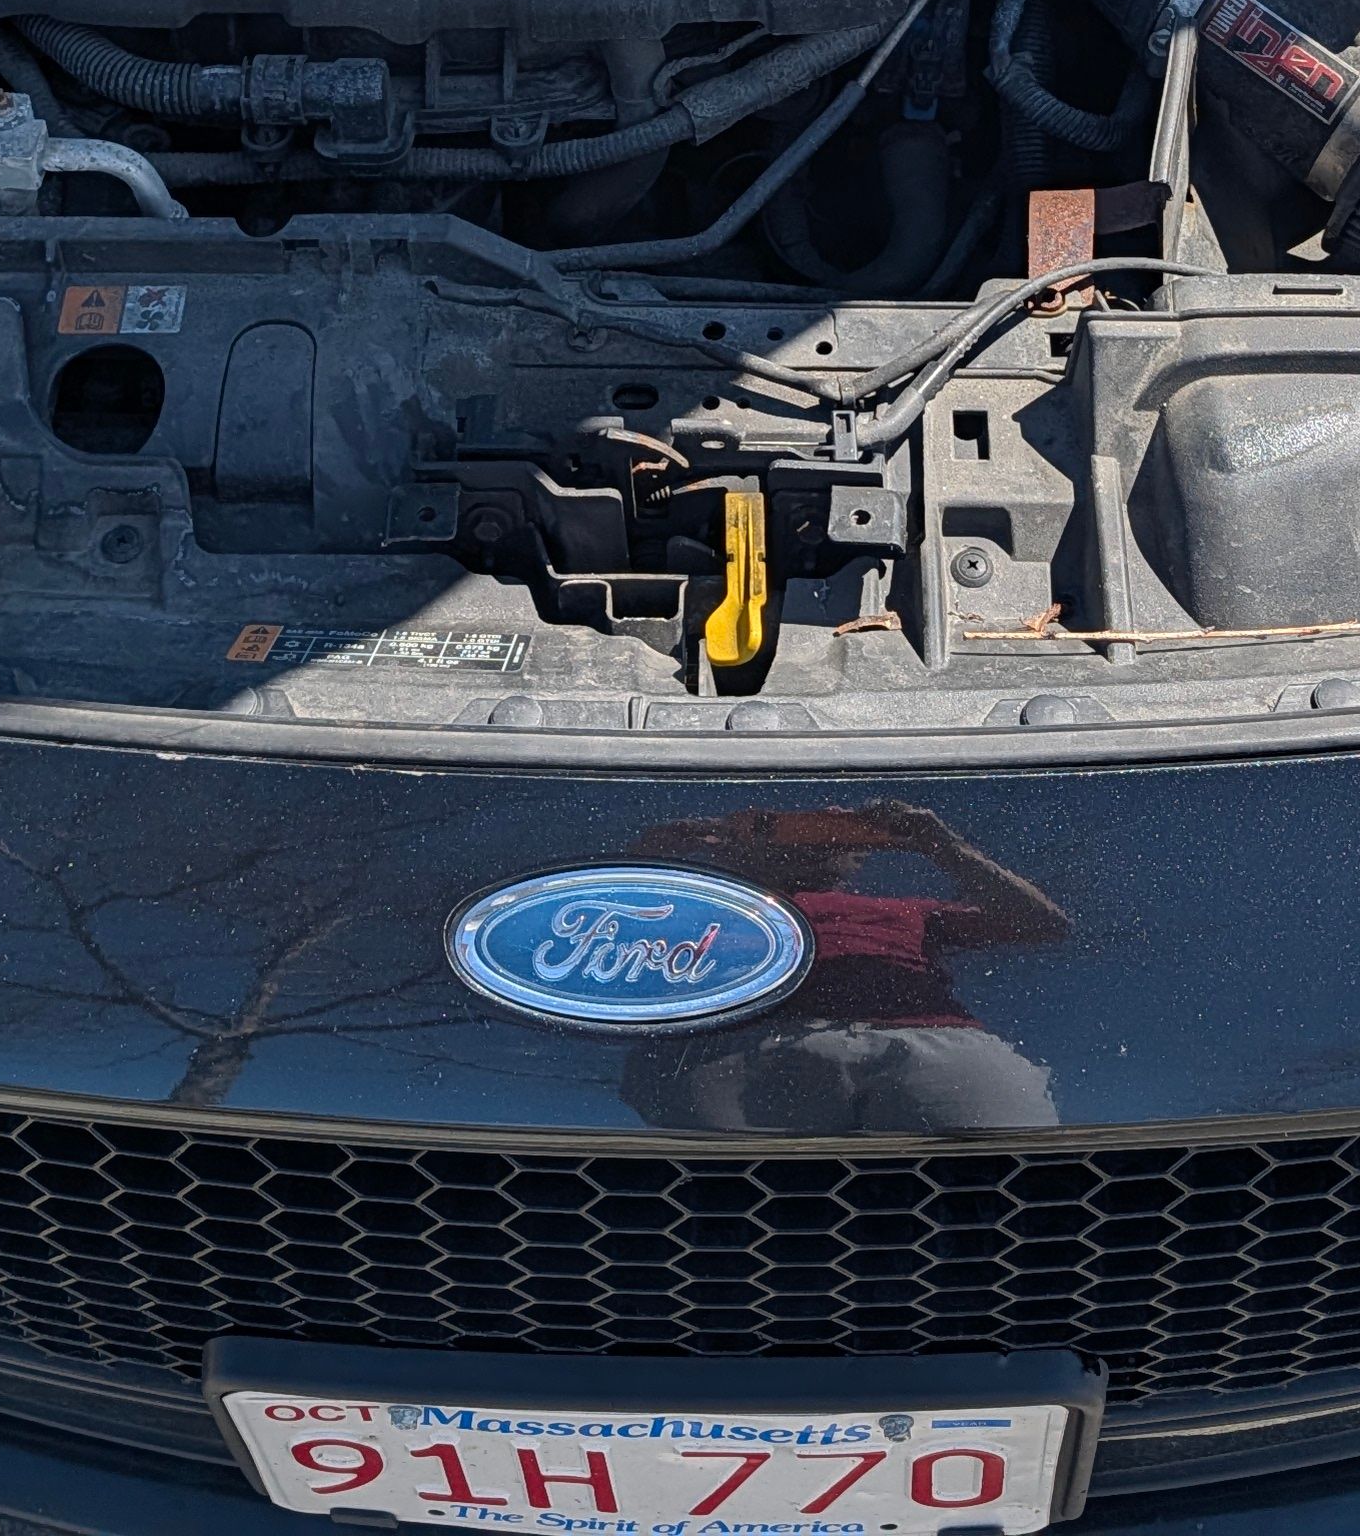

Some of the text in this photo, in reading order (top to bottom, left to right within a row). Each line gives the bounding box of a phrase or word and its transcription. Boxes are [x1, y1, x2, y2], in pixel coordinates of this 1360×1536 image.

[1233, 6, 1344, 101] injen
[328, 630, 379, 638] FoMoCo
[532, 899, 720, 984] Ford
[263, 1404, 380, 1424] OCT
[420, 1406, 871, 1445] Massachusetts
[290, 1438, 1007, 1517] 91H 770
[450, 1504, 865, 1536] The Spirit of America
